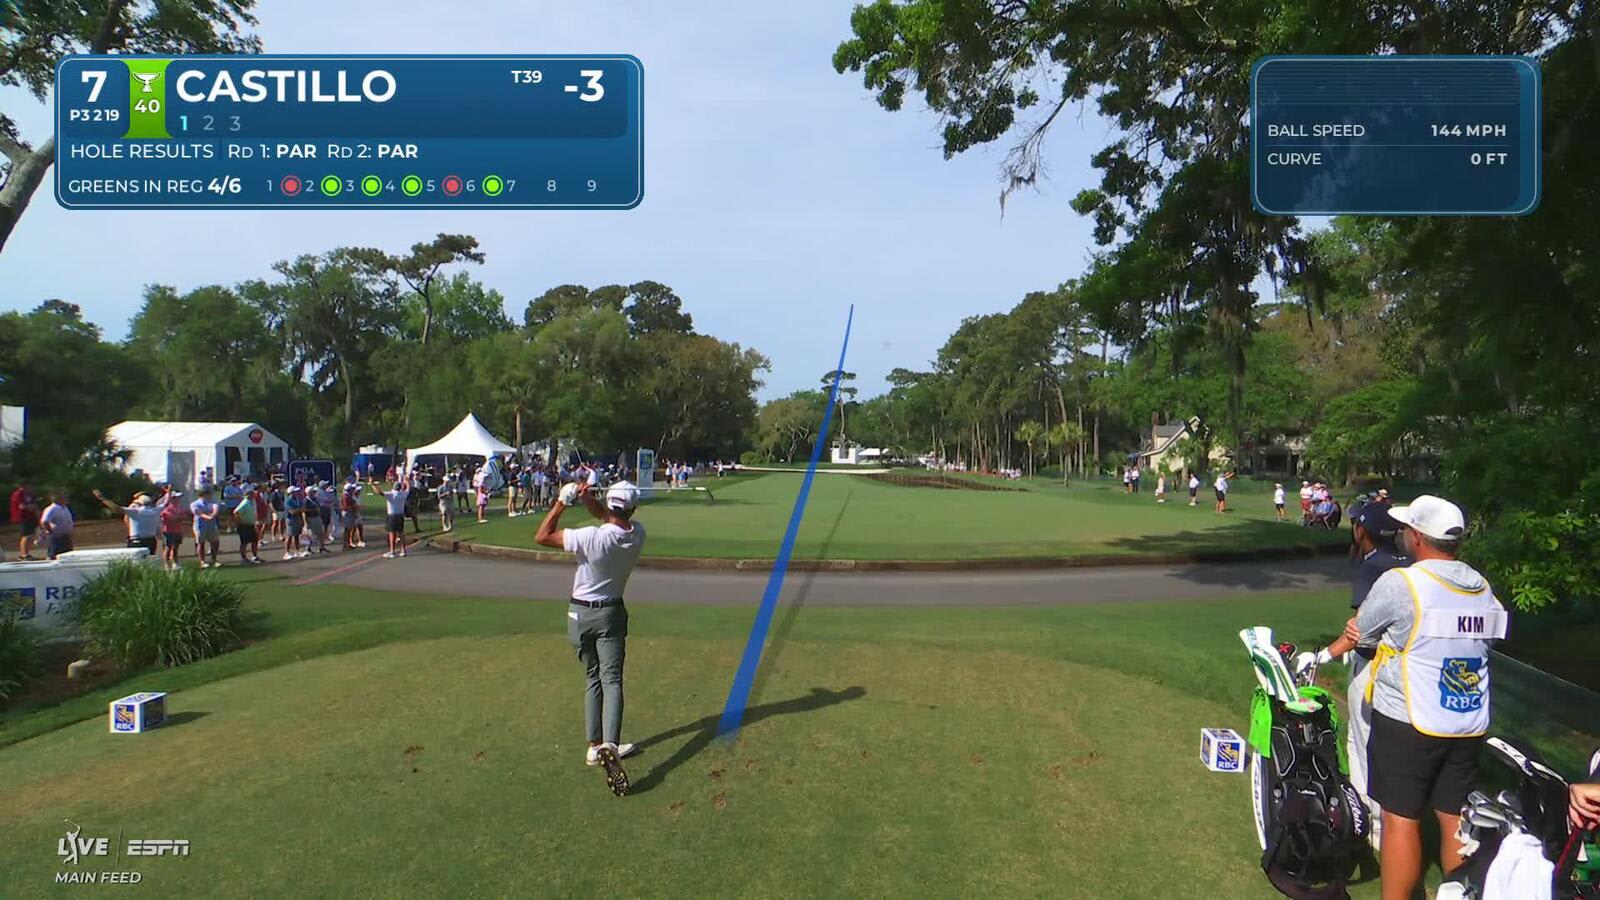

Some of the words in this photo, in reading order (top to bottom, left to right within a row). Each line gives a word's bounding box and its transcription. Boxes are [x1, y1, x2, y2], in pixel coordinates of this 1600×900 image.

[1457, 616, 1484, 633] KIM
[1445, 695, 1481, 709] RBC
[116, 722, 135, 730] RBC
[1218, 761, 1238, 769] RBC
